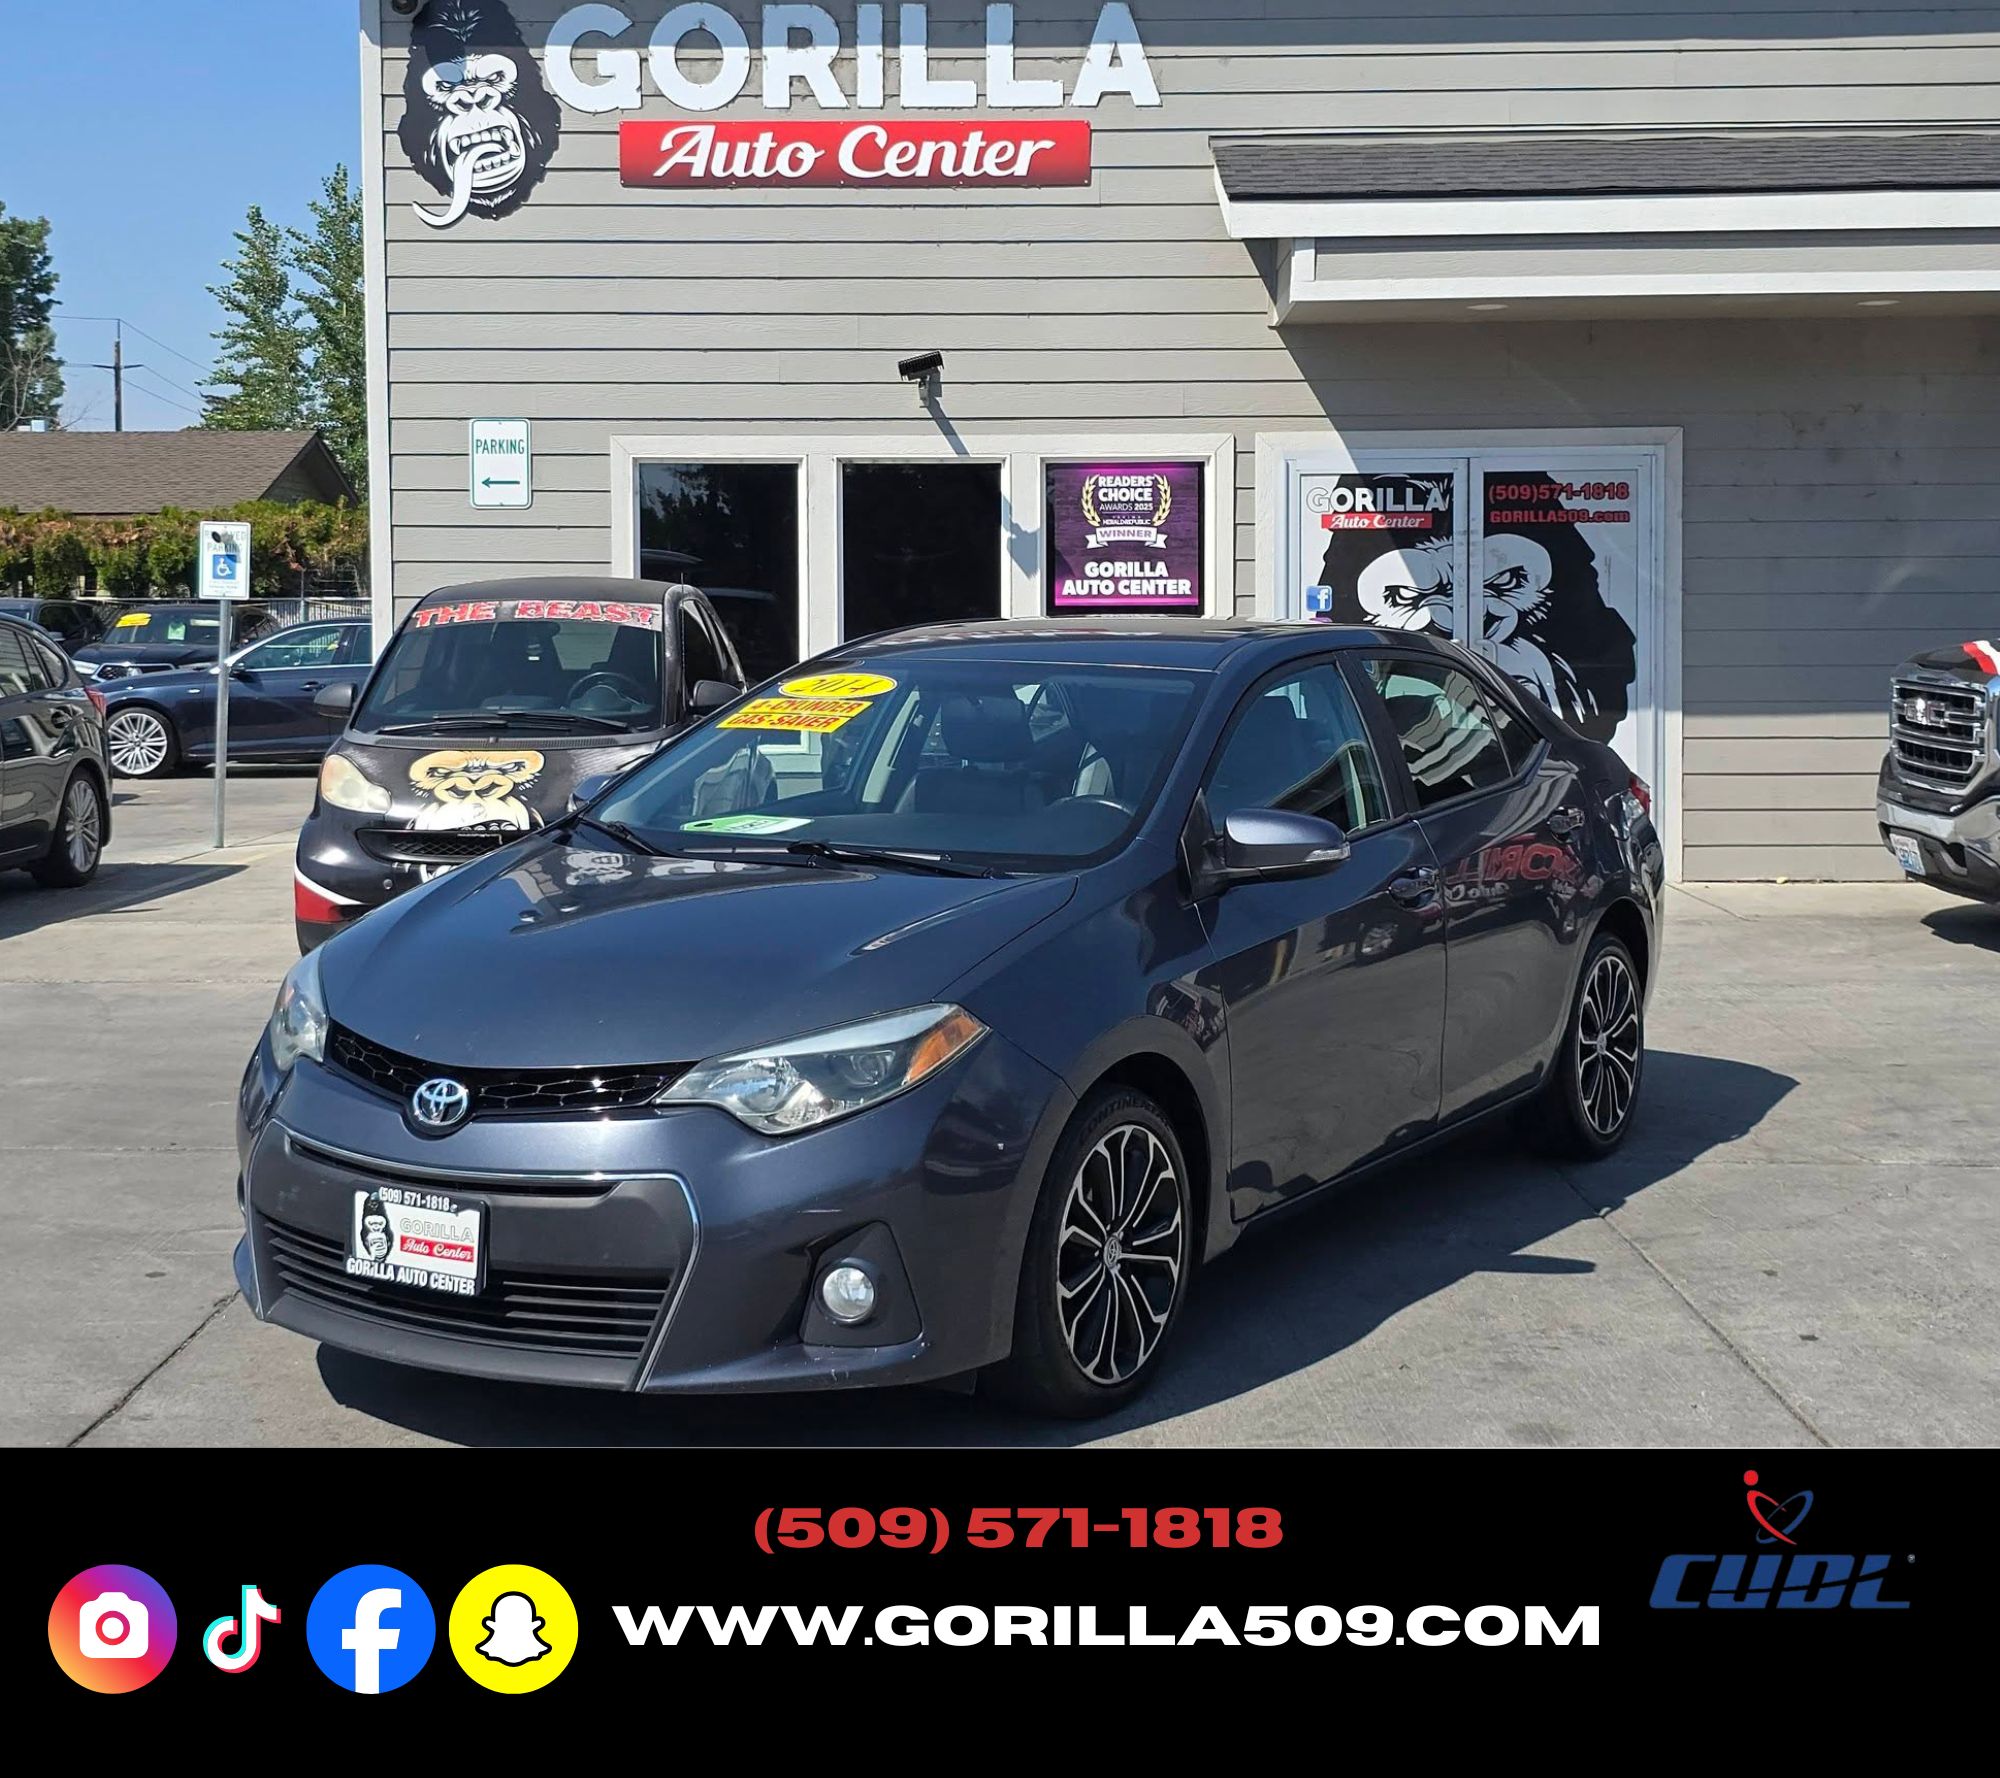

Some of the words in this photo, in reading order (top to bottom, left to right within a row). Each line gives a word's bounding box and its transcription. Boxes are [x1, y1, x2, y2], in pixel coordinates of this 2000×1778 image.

[543, 2, 1162, 113] GORILLA
[653, 124, 826, 179] Auto
[838, 124, 1056, 179] Center
[475, 438, 525, 455] PARKING
[1098, 487, 1153, 502] CHOICE
[1306, 487, 1440, 513] GORILLA
[1488, 482, 1629, 505] (509)571-1818
[1099, 503, 1133, 511] AWARDS
[1134, 502, 1154, 511] 2025
[1489, 508, 1631, 523] GORILLA509.com
[1330, 514, 1371, 529] Auto
[1373, 514, 1425, 529] Center
[1099, 529, 1152, 538] WINNER
[1084, 561, 1169, 578] GORILLA
[1061, 579, 1115, 596] AUTO
[1117, 579, 1192, 596] CENTER
[413, 601, 500, 628] THE
[514, 599, 661, 626] BEAST
[793, 678, 883, 693] 2014
[378, 1186, 403, 1205] (509)
[403, 1191, 450, 1212] 571-1818
[399, 1217, 475, 1243] GORILLA
[401, 1238, 430, 1254] Auto
[433, 1243, 472, 1260] Center
[346, 1258, 395, 1282] GORILLA
[396, 1266, 428, 1287] AUTO
[430, 1272, 476, 1296] CENTER
